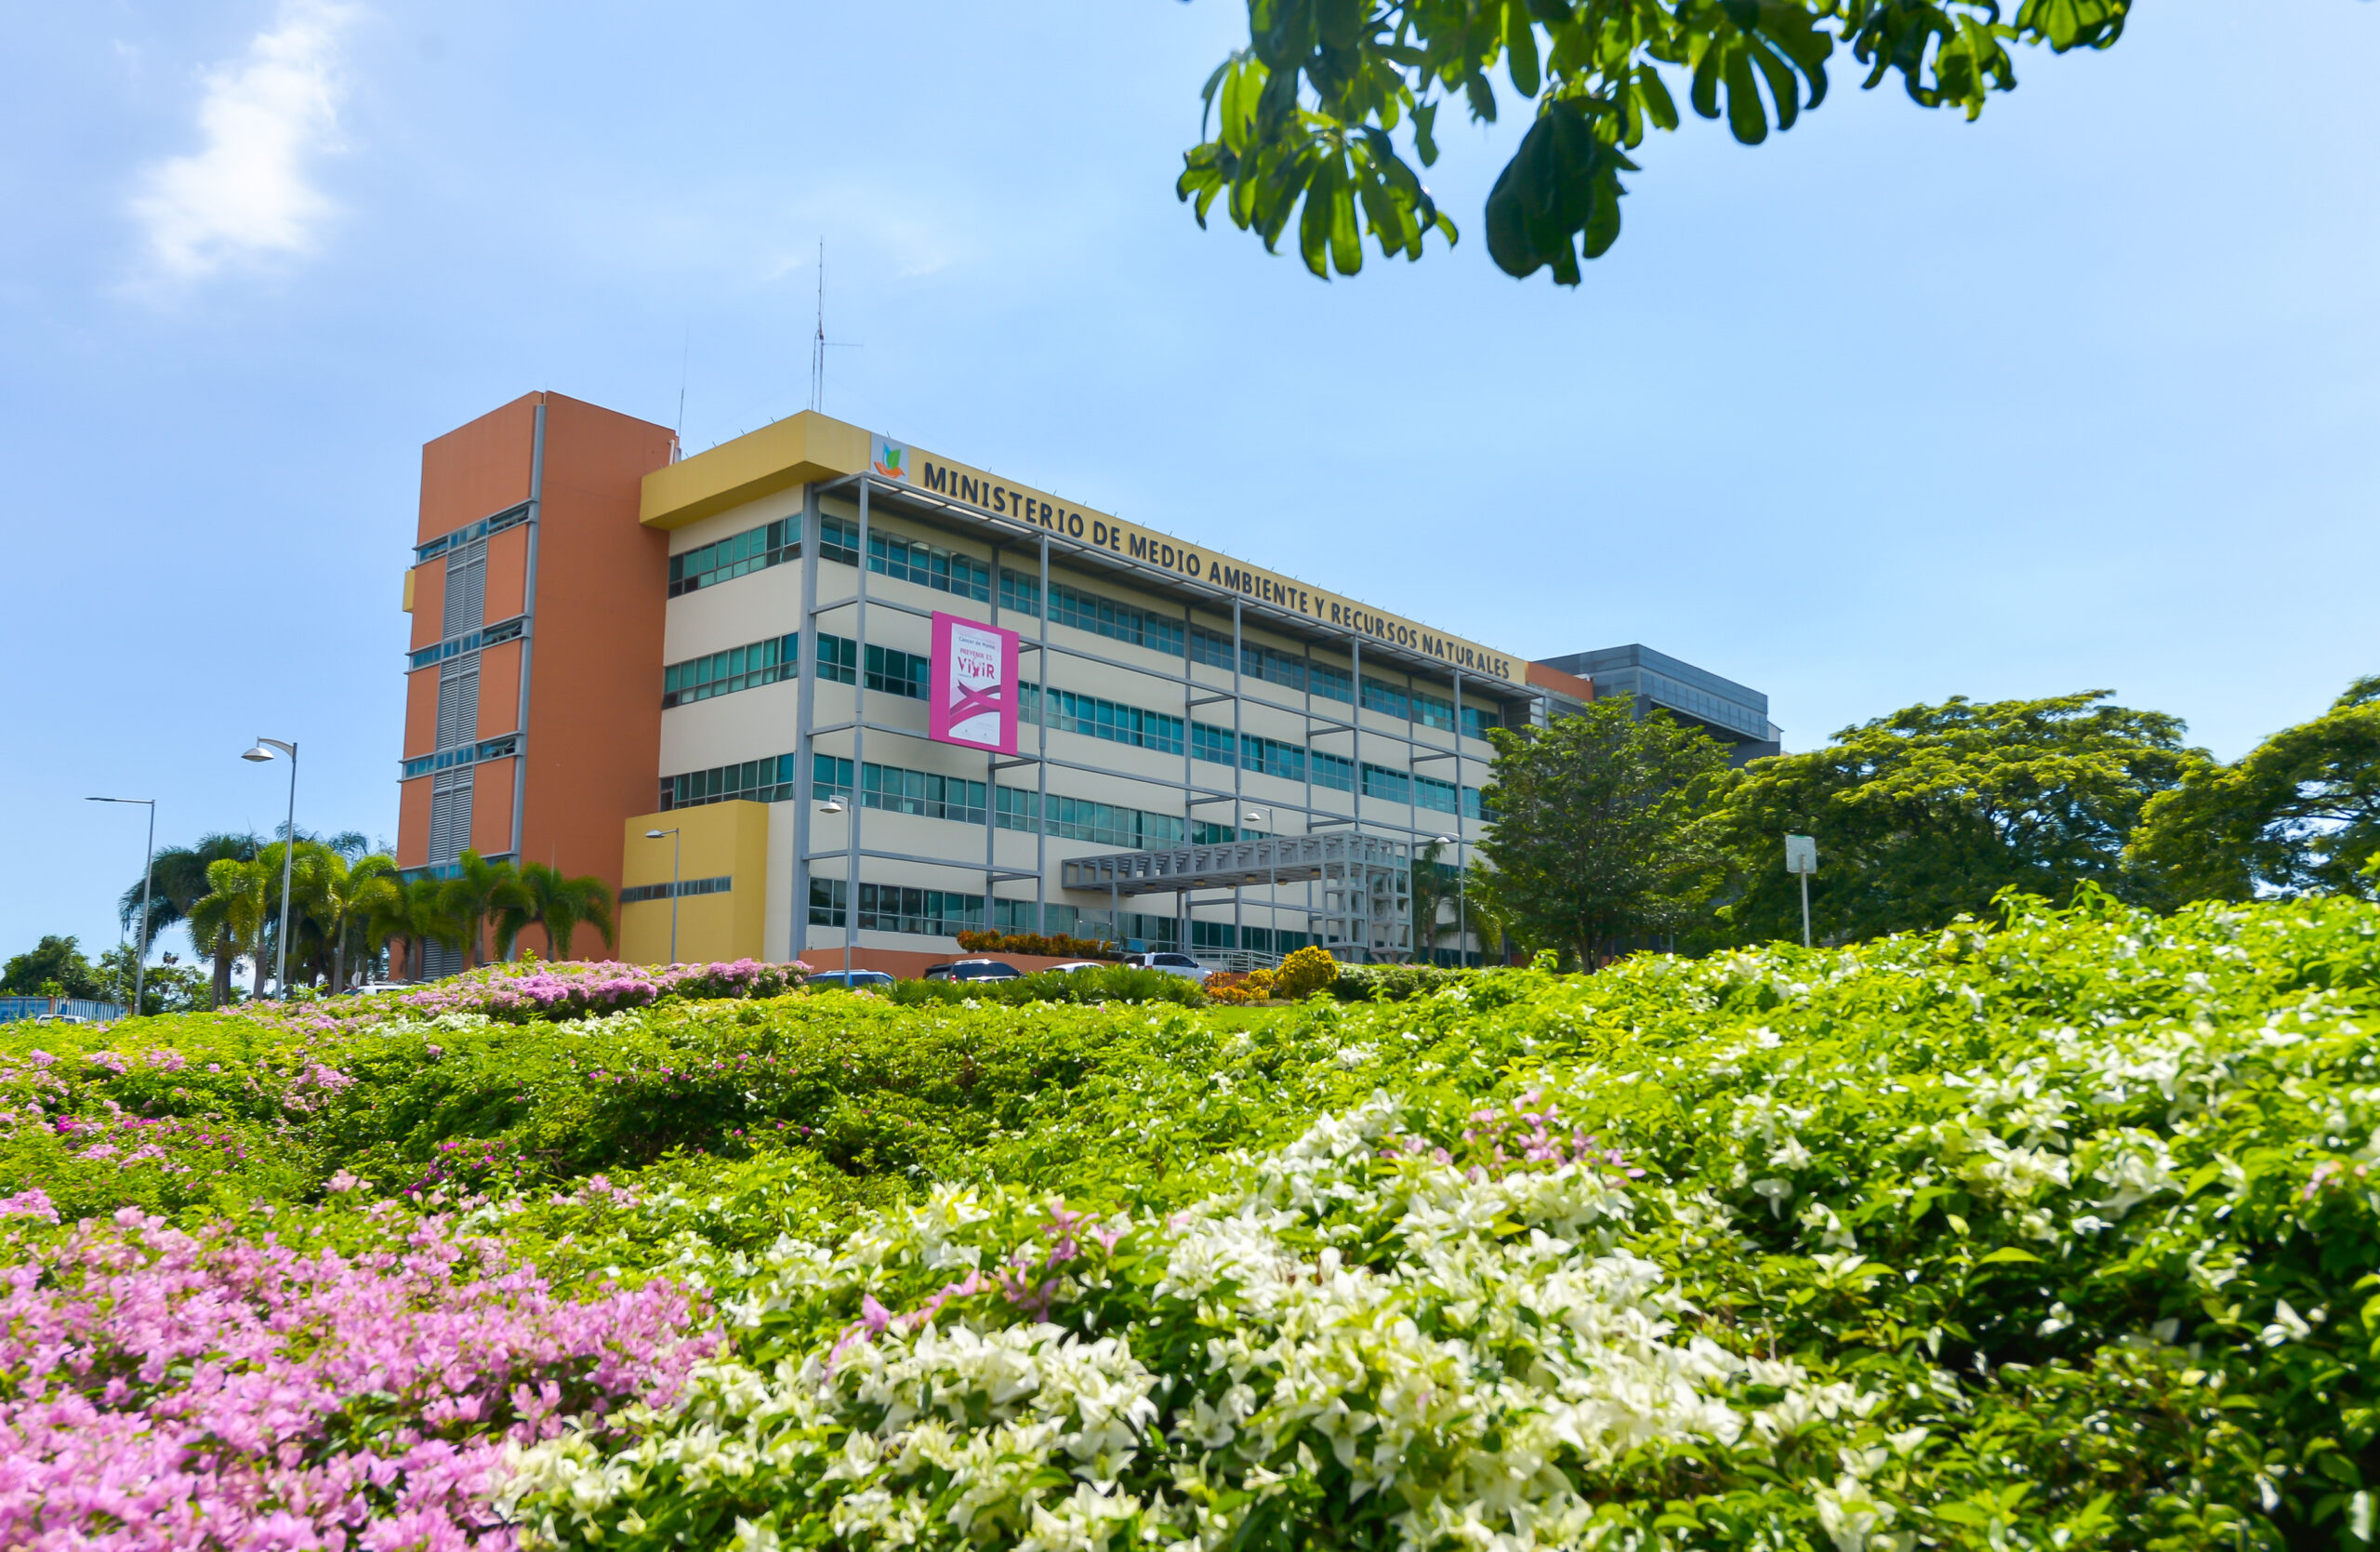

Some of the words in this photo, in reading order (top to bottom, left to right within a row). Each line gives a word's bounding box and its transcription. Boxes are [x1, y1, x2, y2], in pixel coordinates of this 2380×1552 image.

[924, 462, 1084, 537] MINISTERIO
[1093, 521, 1120, 551] DE
[1130, 533, 1200, 576] MEDIO
[1209, 562, 1308, 613] AMBIENTE
[1315, 596, 1325, 618] Y
[1331, 602, 1417, 649] RECURSOS
[1422, 633, 1509, 679] NATURALES
